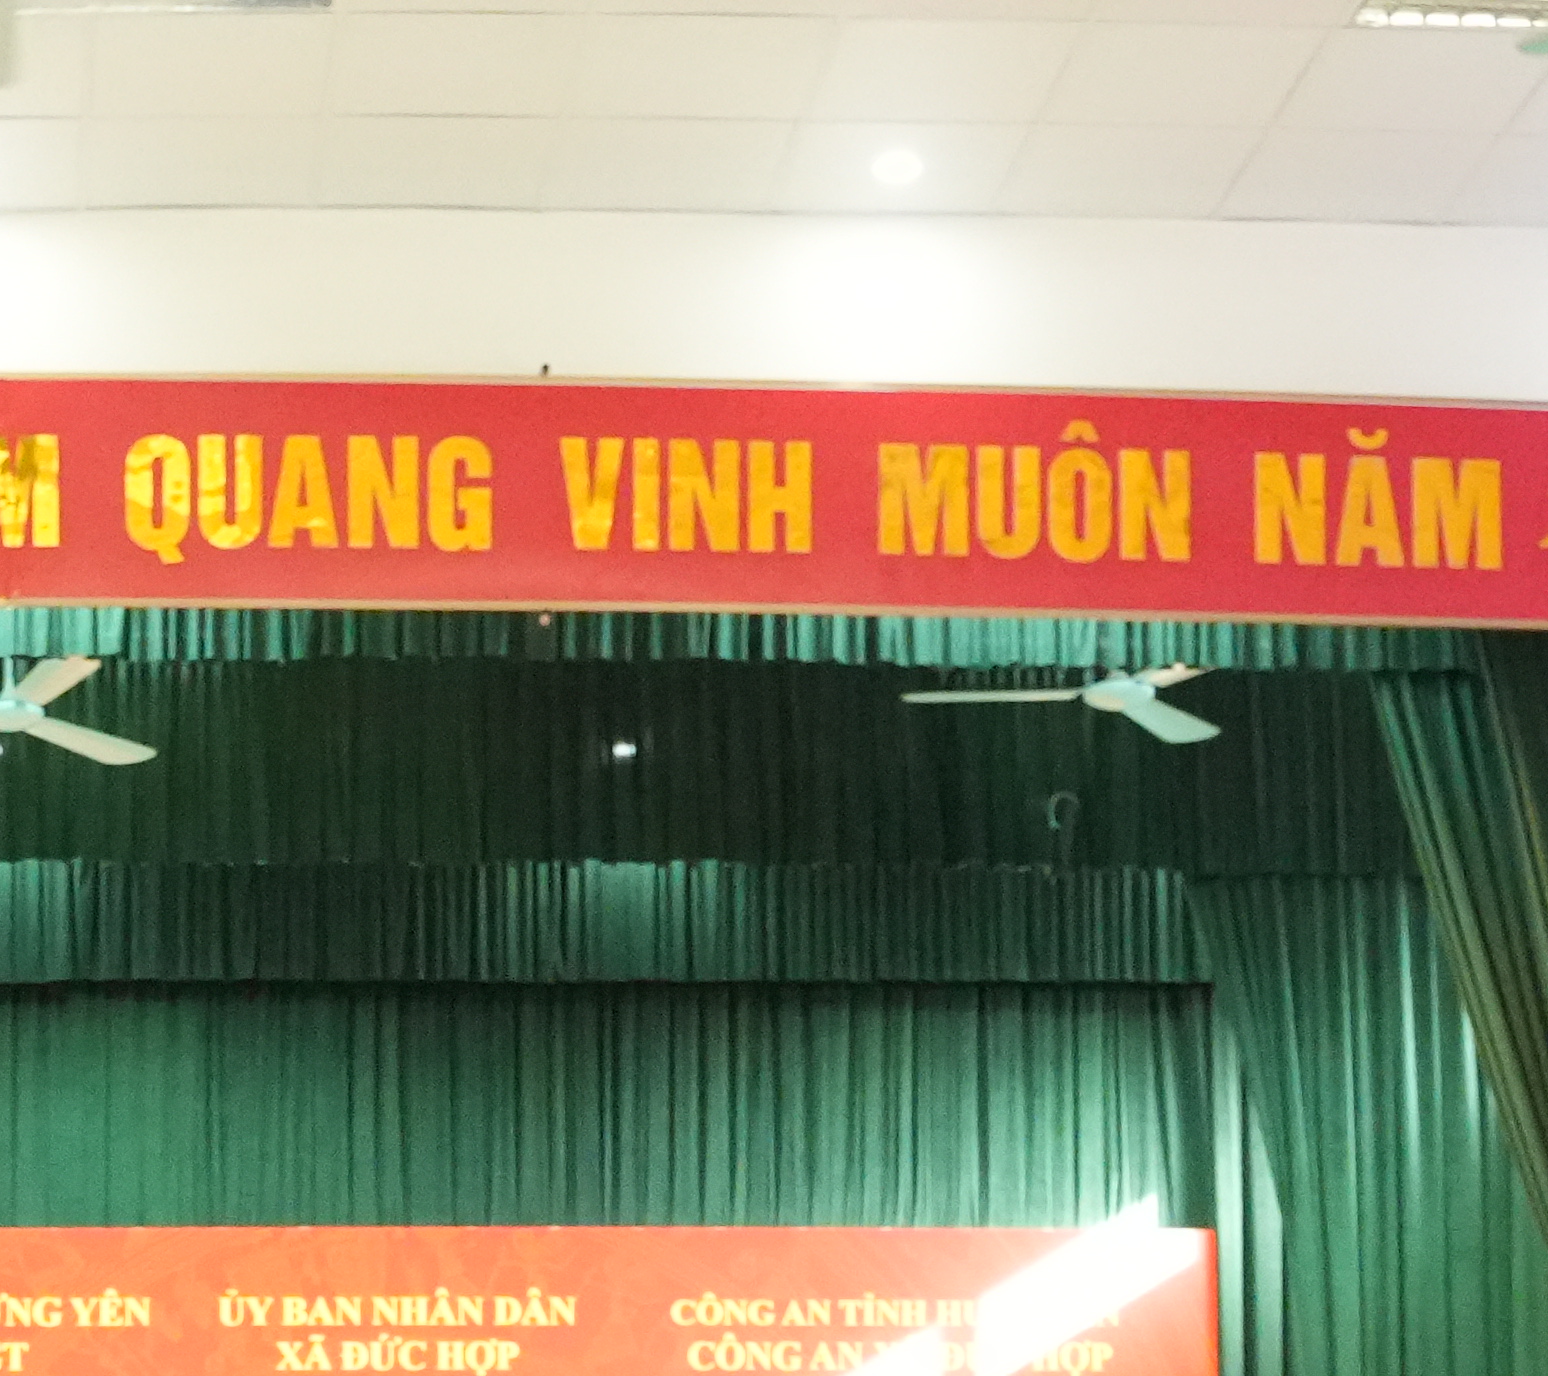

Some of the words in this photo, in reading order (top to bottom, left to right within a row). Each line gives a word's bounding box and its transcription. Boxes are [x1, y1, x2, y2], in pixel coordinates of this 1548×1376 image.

[124, 434, 492, 564] QUANG
[560, 437, 812, 553] VINH
[877, 420, 1191, 563] MUÔN
[1253, 428, 1503, 571] NĂM
[71, 1288, 149, 1326] YÊN
[220, 1290, 274, 1327] ỦY
[283, 1297, 361, 1326] BAN
[372, 1287, 483, 1325] NHÂN
[495, 1288, 575, 1325] DÂN
[670, 1292, 776, 1326] CÔNG
[782, 1299, 831, 1326] AN
[838, 1291, 926, 1328] TỈNH
[277, 1334, 332, 1370] XÃ
[340, 1333, 426, 1371] ĐỨC
[438, 1339, 519, 1376] HỢP
[688, 1332, 803, 1371] CÔNG
[811, 1341, 863, 1371] AN
